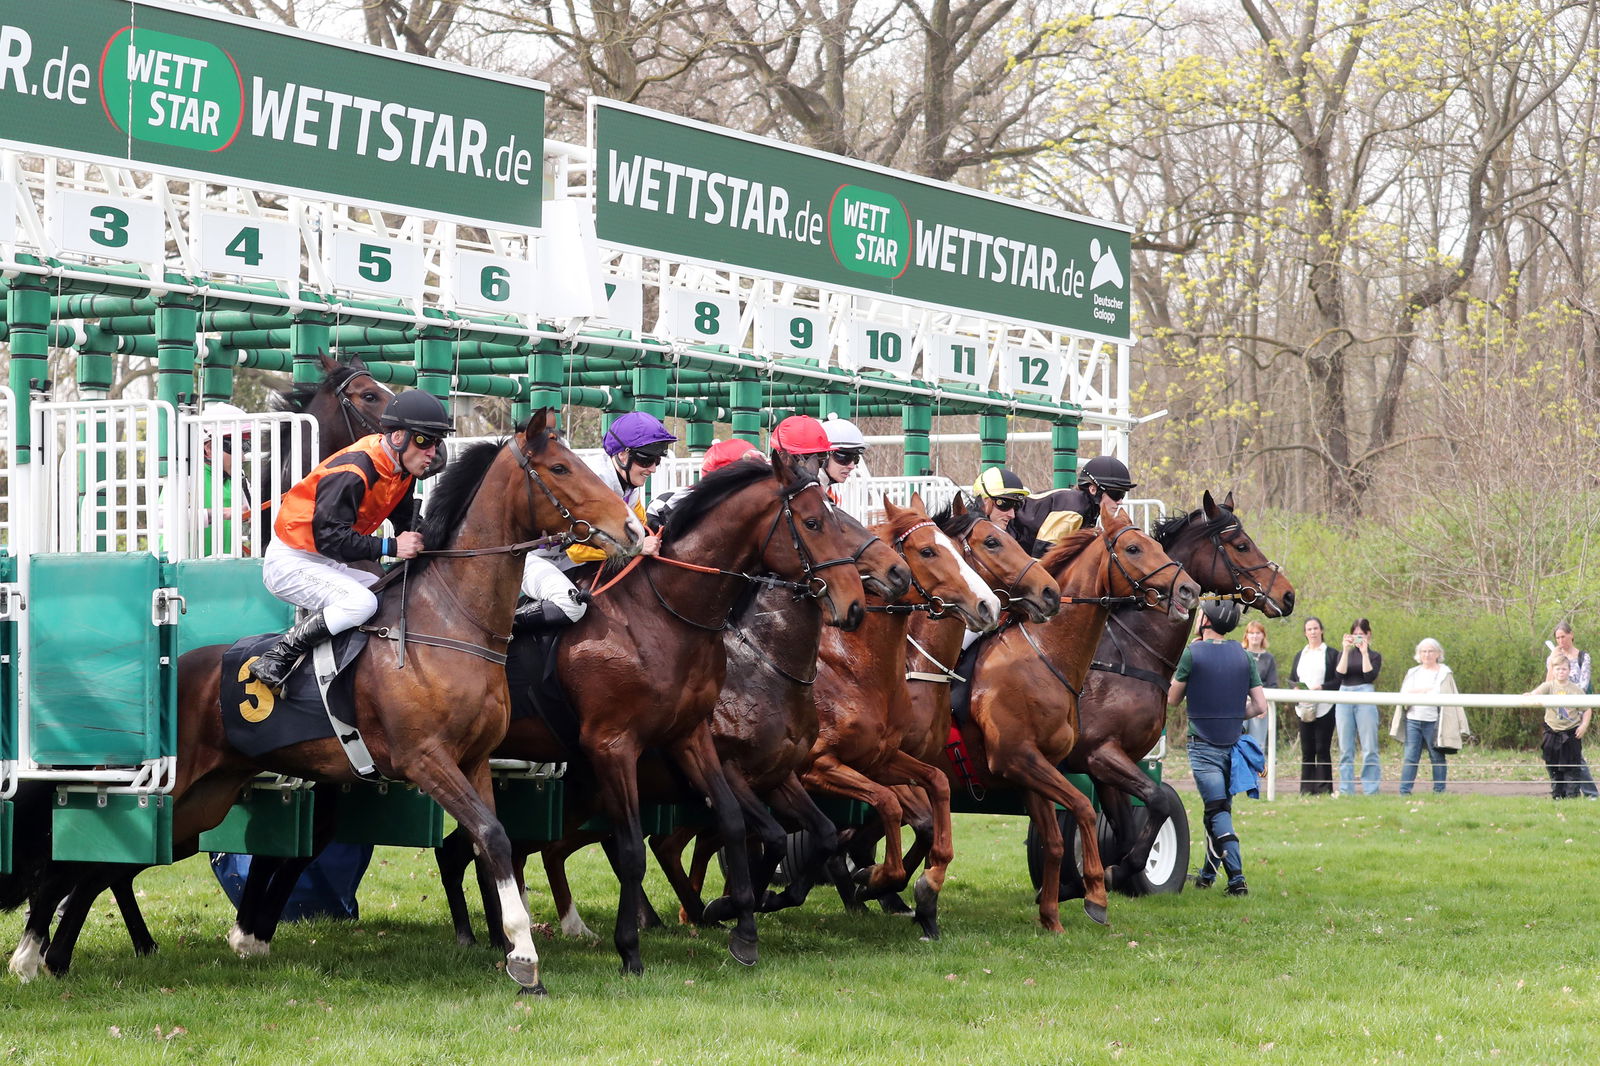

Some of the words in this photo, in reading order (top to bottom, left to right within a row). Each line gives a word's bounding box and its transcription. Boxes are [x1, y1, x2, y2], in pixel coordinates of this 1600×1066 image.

[127, 45, 208, 93] WETT
[147, 91, 220, 137] STAR
[252, 76, 532, 186] WETTSTAR.de
[608, 149, 823, 246] WETTSTAR.de
[89, 206, 129, 248] 3
[843, 198, 890, 234] WETT
[225, 227, 263, 266] 4
[358, 244, 392, 283] 5
[855, 232, 898, 267] STAR
[915, 219, 1084, 299] WETTSTAR.de
[481, 266, 510, 302] 6
[1093, 293, 1124, 309] Deutscher
[694, 301, 720, 335] 8
[789, 317, 813, 349] 9
[1093, 307, 1116, 324] Galopp
[866, 330, 902, 363] 10
[951, 345, 976, 375] 11
[1018, 356, 1049, 386] 12
[238, 655, 275, 723] 3
